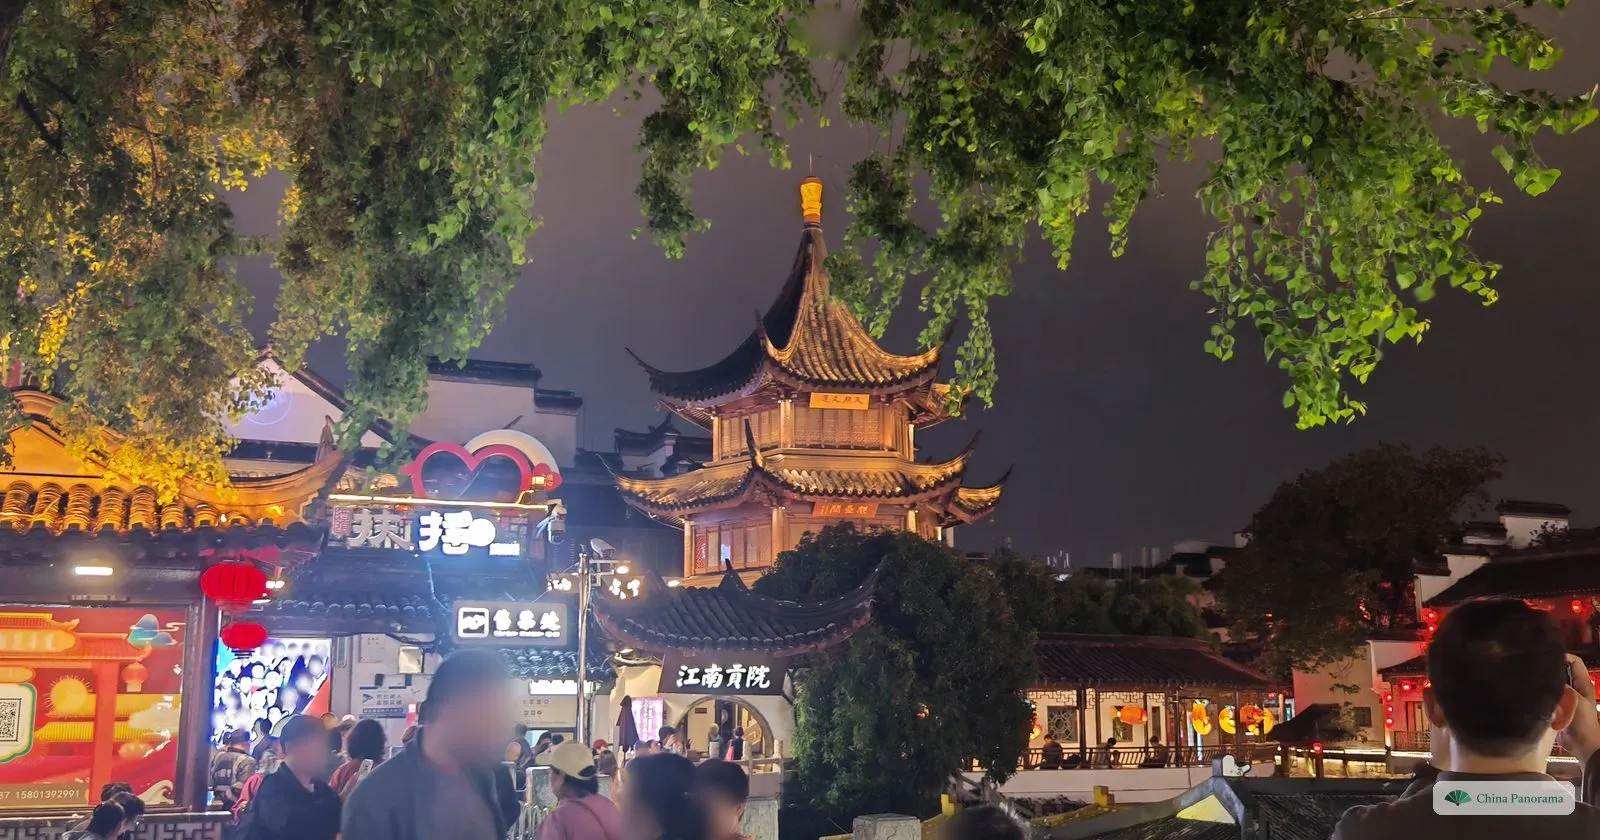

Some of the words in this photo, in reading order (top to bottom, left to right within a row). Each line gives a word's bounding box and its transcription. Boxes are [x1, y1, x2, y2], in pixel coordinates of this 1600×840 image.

[676, 663, 771, 690] 江南貢院
[16, 790, 80, 799] 15801392991
